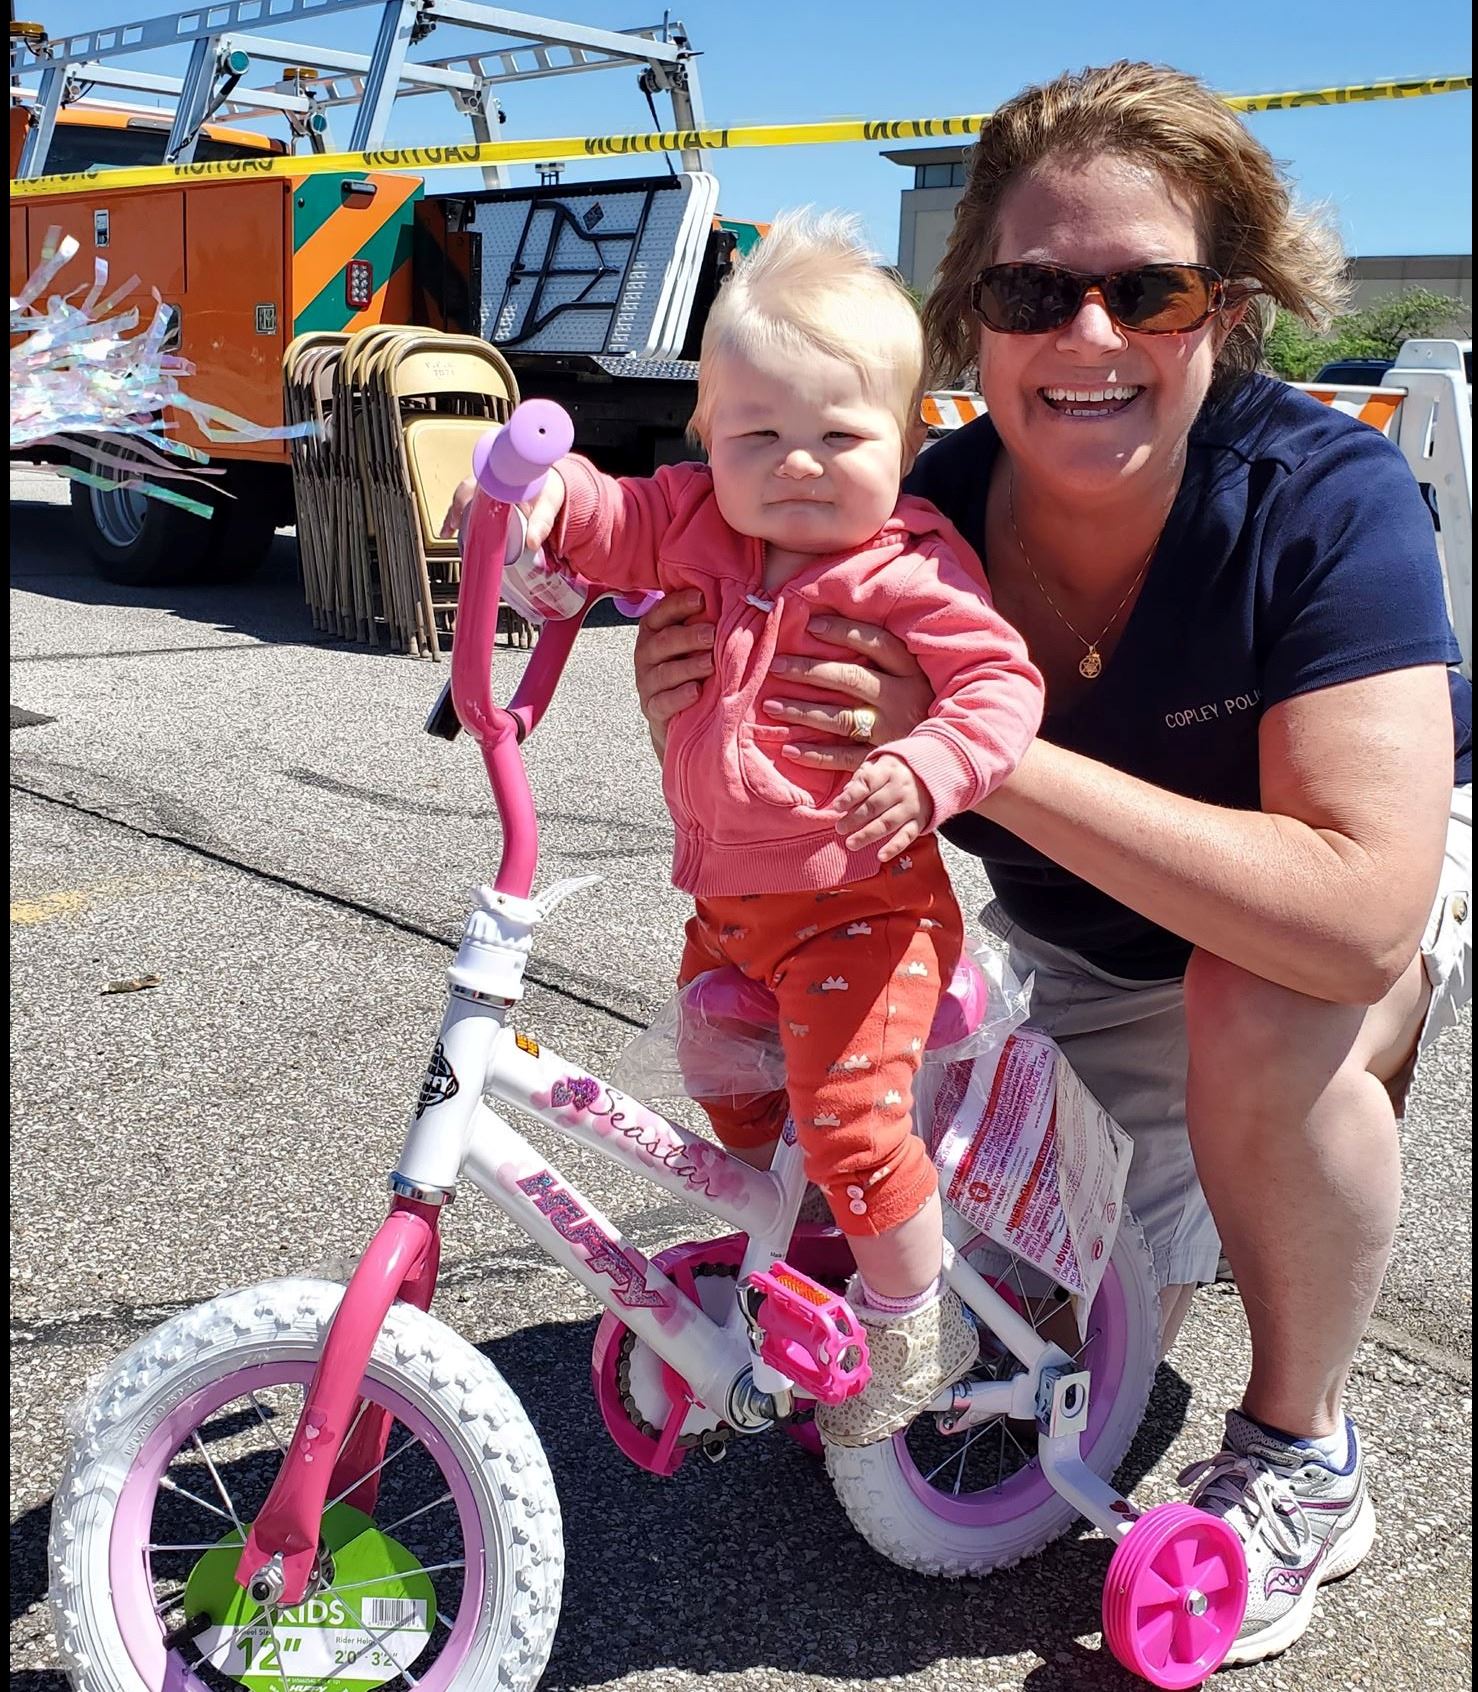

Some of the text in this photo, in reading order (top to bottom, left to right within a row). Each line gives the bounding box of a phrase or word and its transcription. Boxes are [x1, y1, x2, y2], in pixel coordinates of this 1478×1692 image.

[1165, 703, 1219, 728] COPLEY
[586, 1087, 720, 1198] Seastar
[515, 1169, 671, 1308] HUFFY
[237, 1637, 303, 1671] 12"
[335, 1636, 354, 1644] Rider
